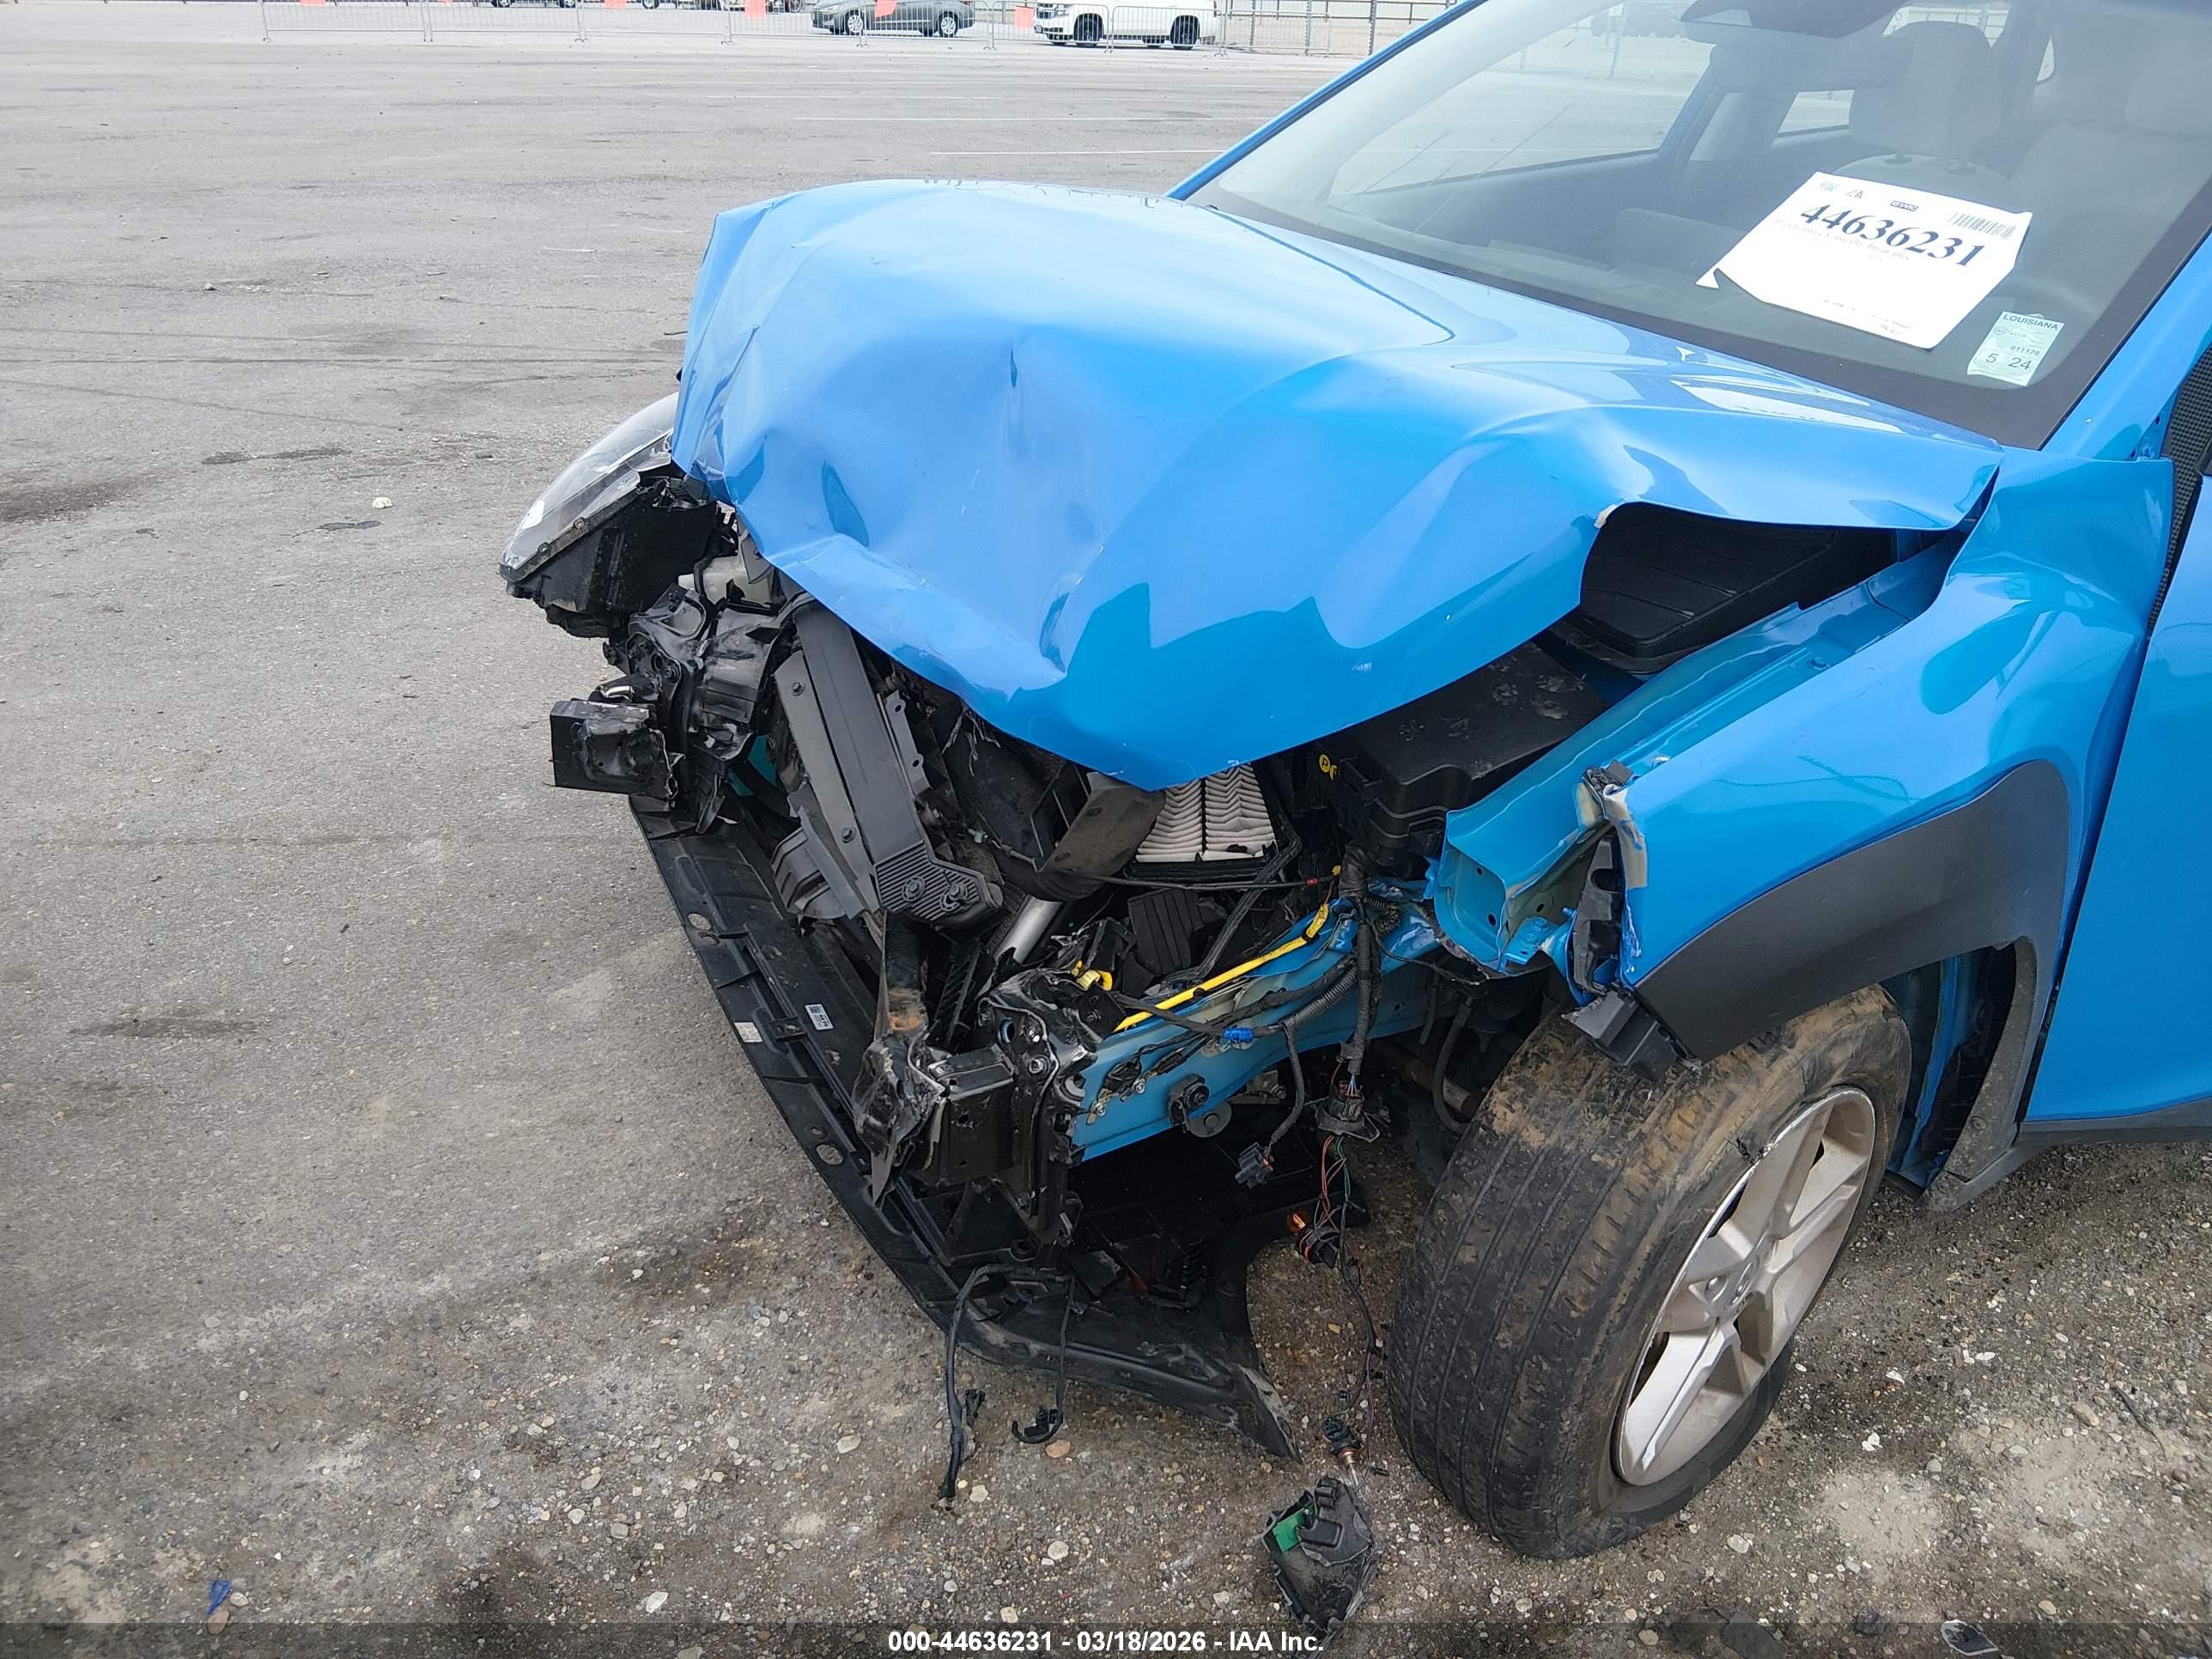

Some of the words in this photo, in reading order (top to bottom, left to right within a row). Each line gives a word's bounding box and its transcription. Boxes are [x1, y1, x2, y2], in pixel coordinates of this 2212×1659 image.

[1800, 204, 1985, 267] 44636231
[2003, 313, 2058, 331] LOUISIANA
[1985, 353, 2000, 363] 5
[2008, 357, 2033, 370] 24
